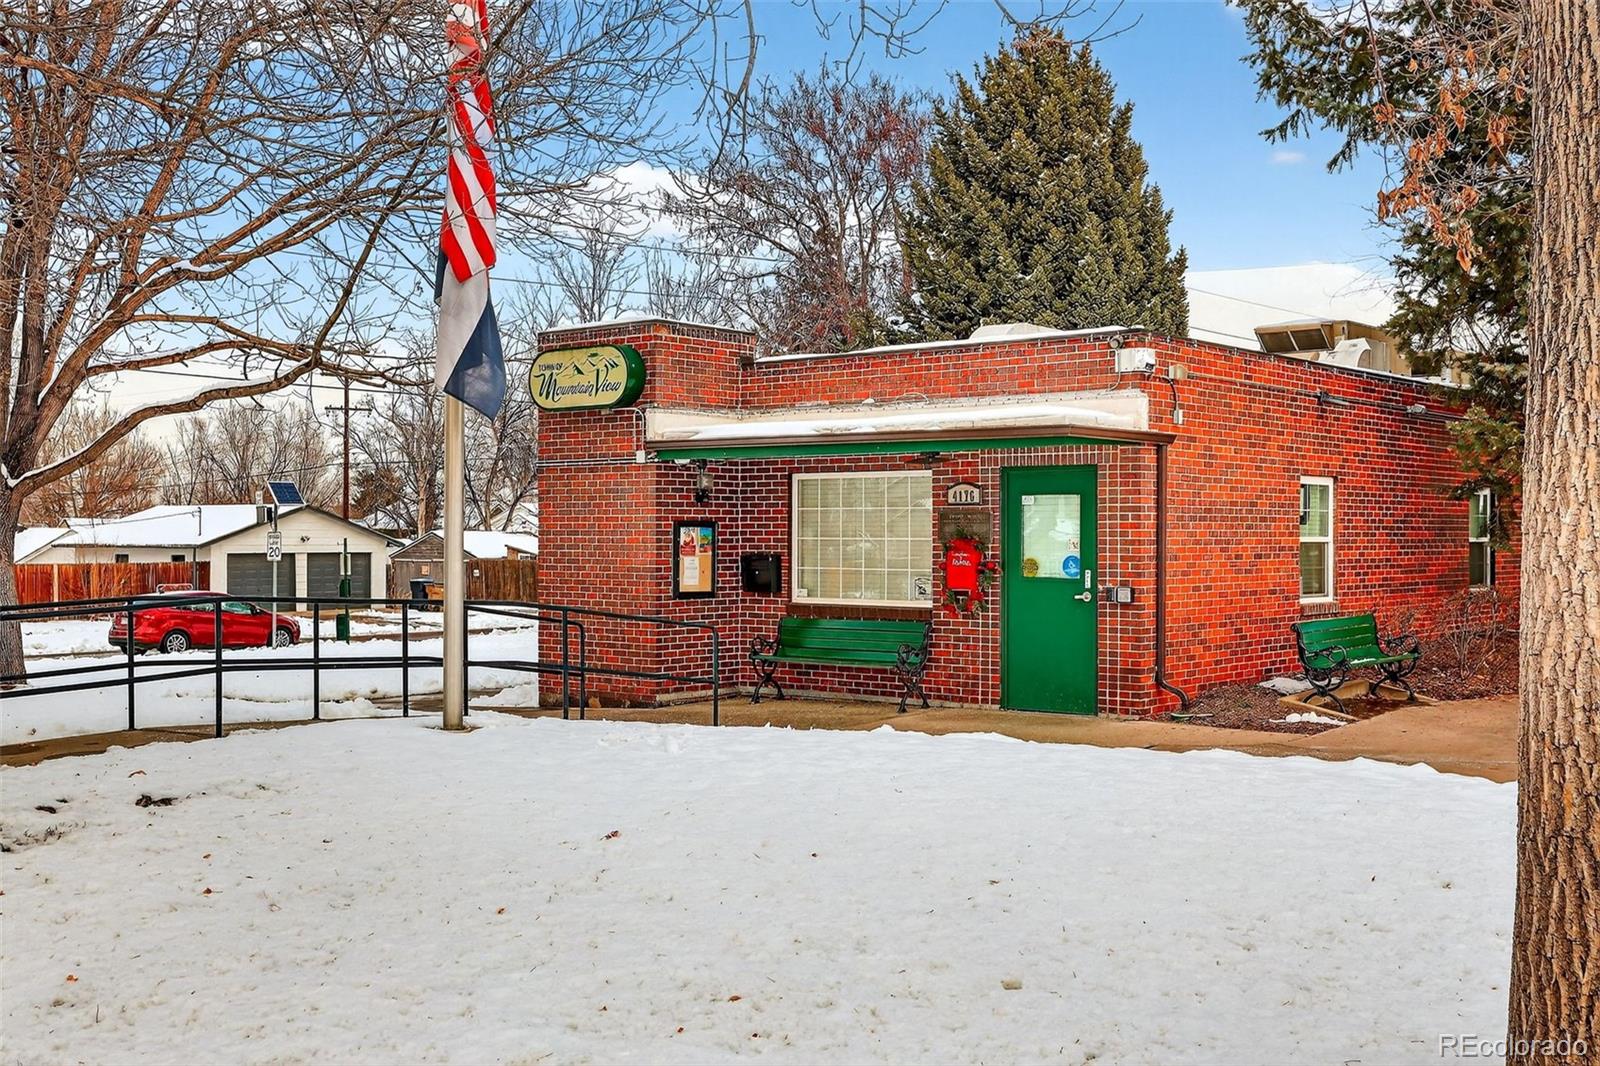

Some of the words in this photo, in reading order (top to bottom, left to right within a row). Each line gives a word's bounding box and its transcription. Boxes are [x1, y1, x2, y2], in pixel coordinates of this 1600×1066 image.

[533, 371, 595, 403] Mountain
[594, 363, 622, 398] View
[268, 546, 280, 558] 20
